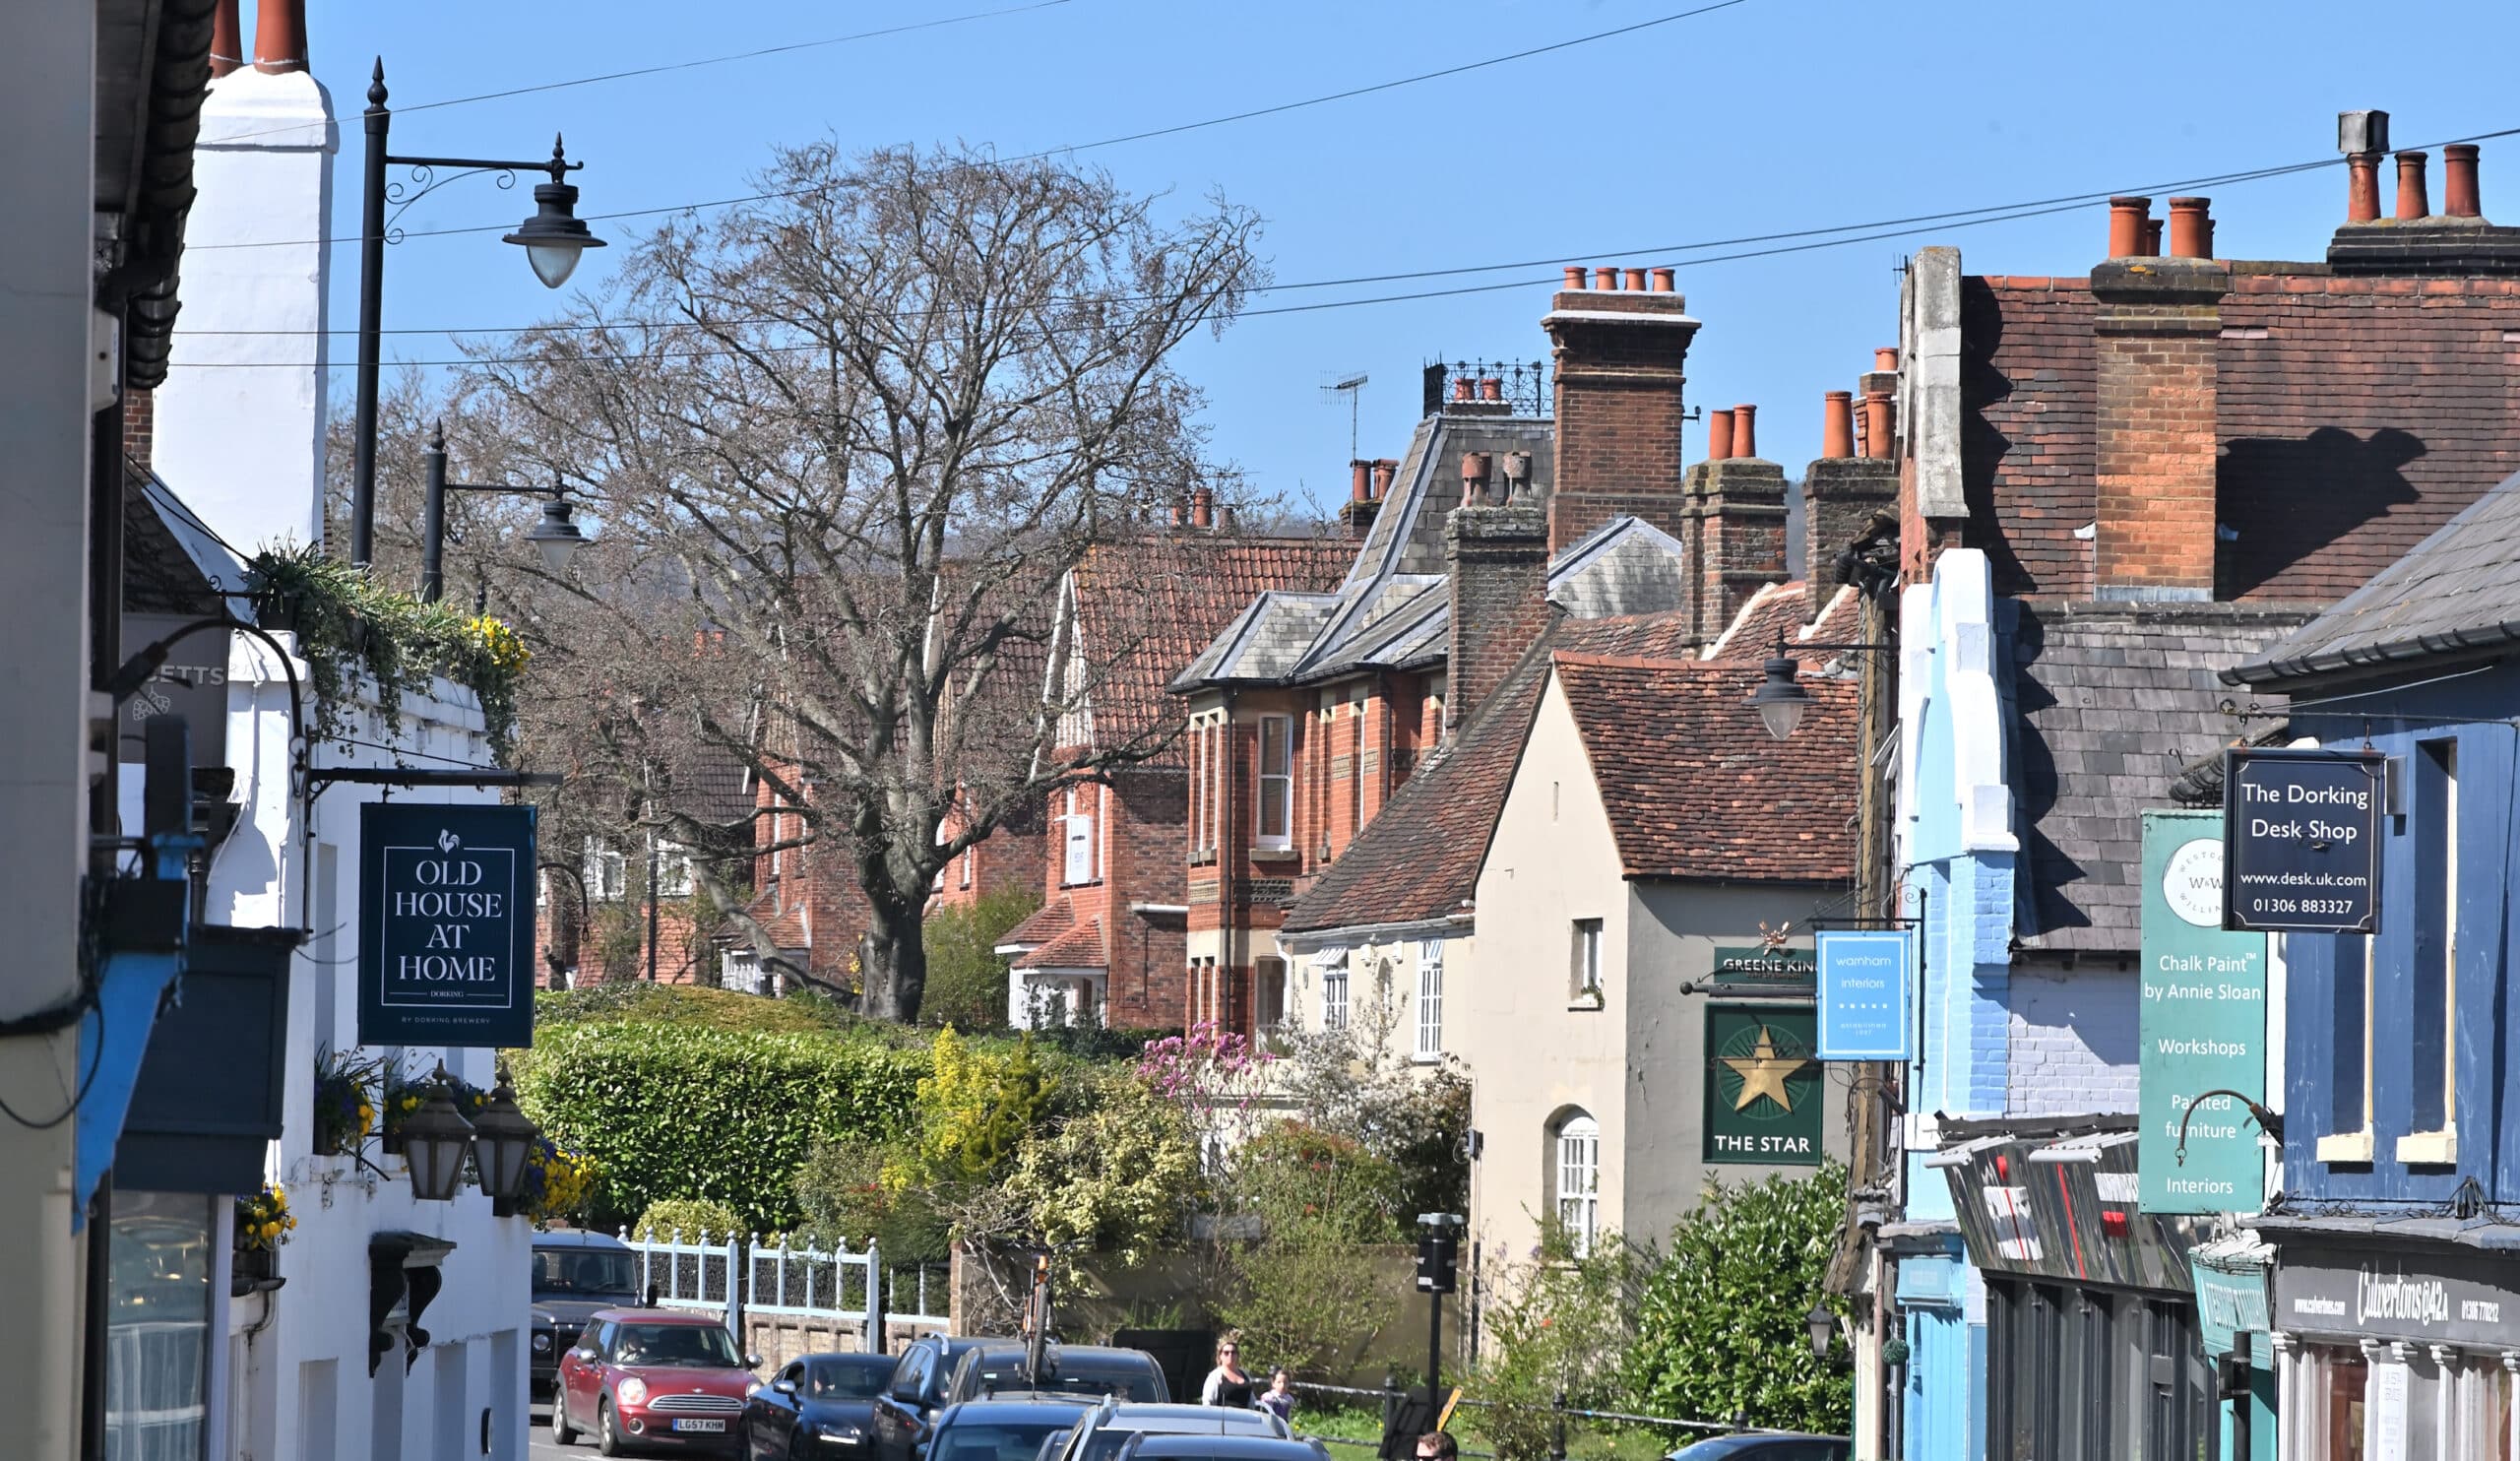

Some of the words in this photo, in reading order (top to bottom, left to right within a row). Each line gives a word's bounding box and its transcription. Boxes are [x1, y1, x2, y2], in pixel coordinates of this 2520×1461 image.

[147, 665, 224, 685] ETTS
[2241, 784, 2280, 803] The
[2288, 785, 2368, 810] Dorking
[2251, 819, 2302, 839] Desk
[2308, 820, 2358, 845] Shop
[415, 859, 482, 886] OLD
[2240, 872, 2366, 887] www.desk.uk.com
[395, 892, 503, 919] HOUSE
[2253, 899, 2297, 913] 01306
[2301, 900, 2353, 914] 883327
[425, 923, 470, 949] AT
[399, 956, 495, 982] HOME
[1724, 958, 1782, 972] GREENE
[1787, 960, 1818, 973] KIN
[1836, 956, 1892, 967] warnham
[2159, 954, 2204, 973] Chalk
[1842, 978, 1885, 988] interiors
[2144, 983, 2165, 1002] by
[2168, 984, 2215, 1001] Annie
[2218, 984, 2261, 1002] Sloan
[2158, 1039, 2246, 1057] Workshops
[2165, 1121, 2236, 1139] funiture
[1715, 1135, 1753, 1152] THE
[1760, 1136, 1811, 1153] STAR
[2167, 1177, 2234, 1195] Interiors
